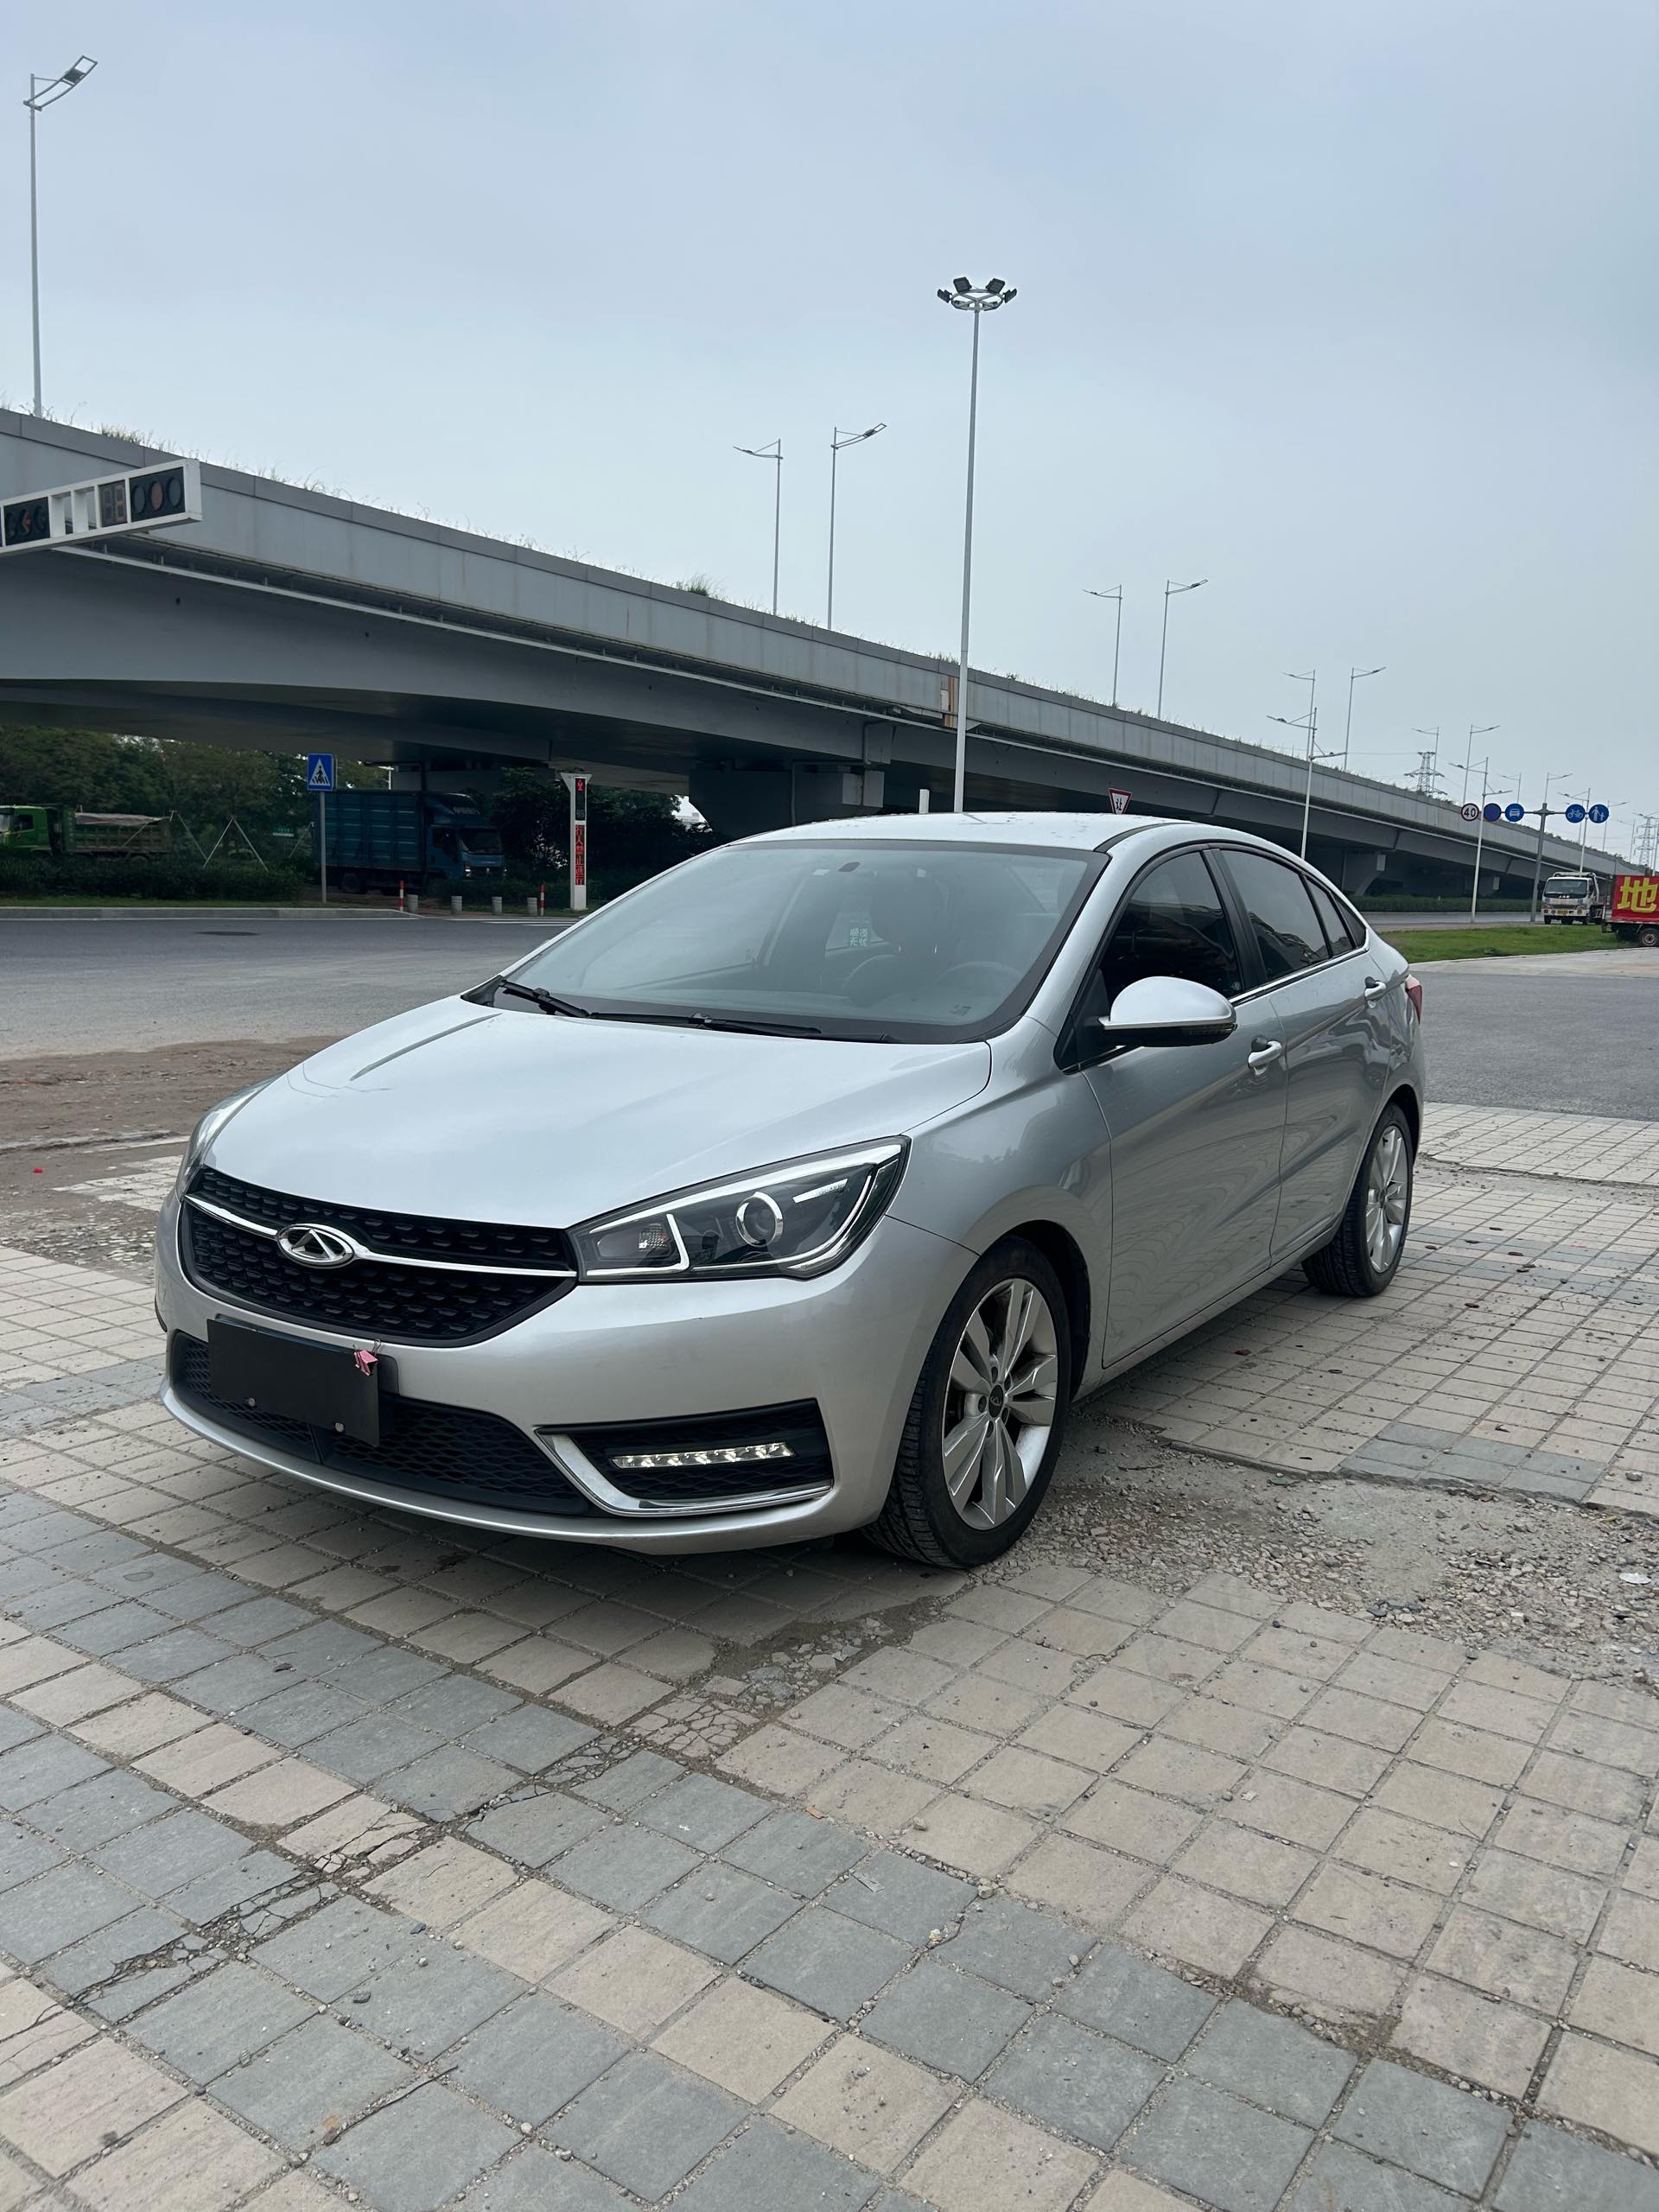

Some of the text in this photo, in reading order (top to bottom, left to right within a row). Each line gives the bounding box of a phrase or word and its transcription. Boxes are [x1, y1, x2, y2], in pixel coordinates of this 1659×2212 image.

[1116, 798, 1123, 811] 让
[1464, 808, 1477, 817] 40
[1617, 876, 1658, 913] 地
